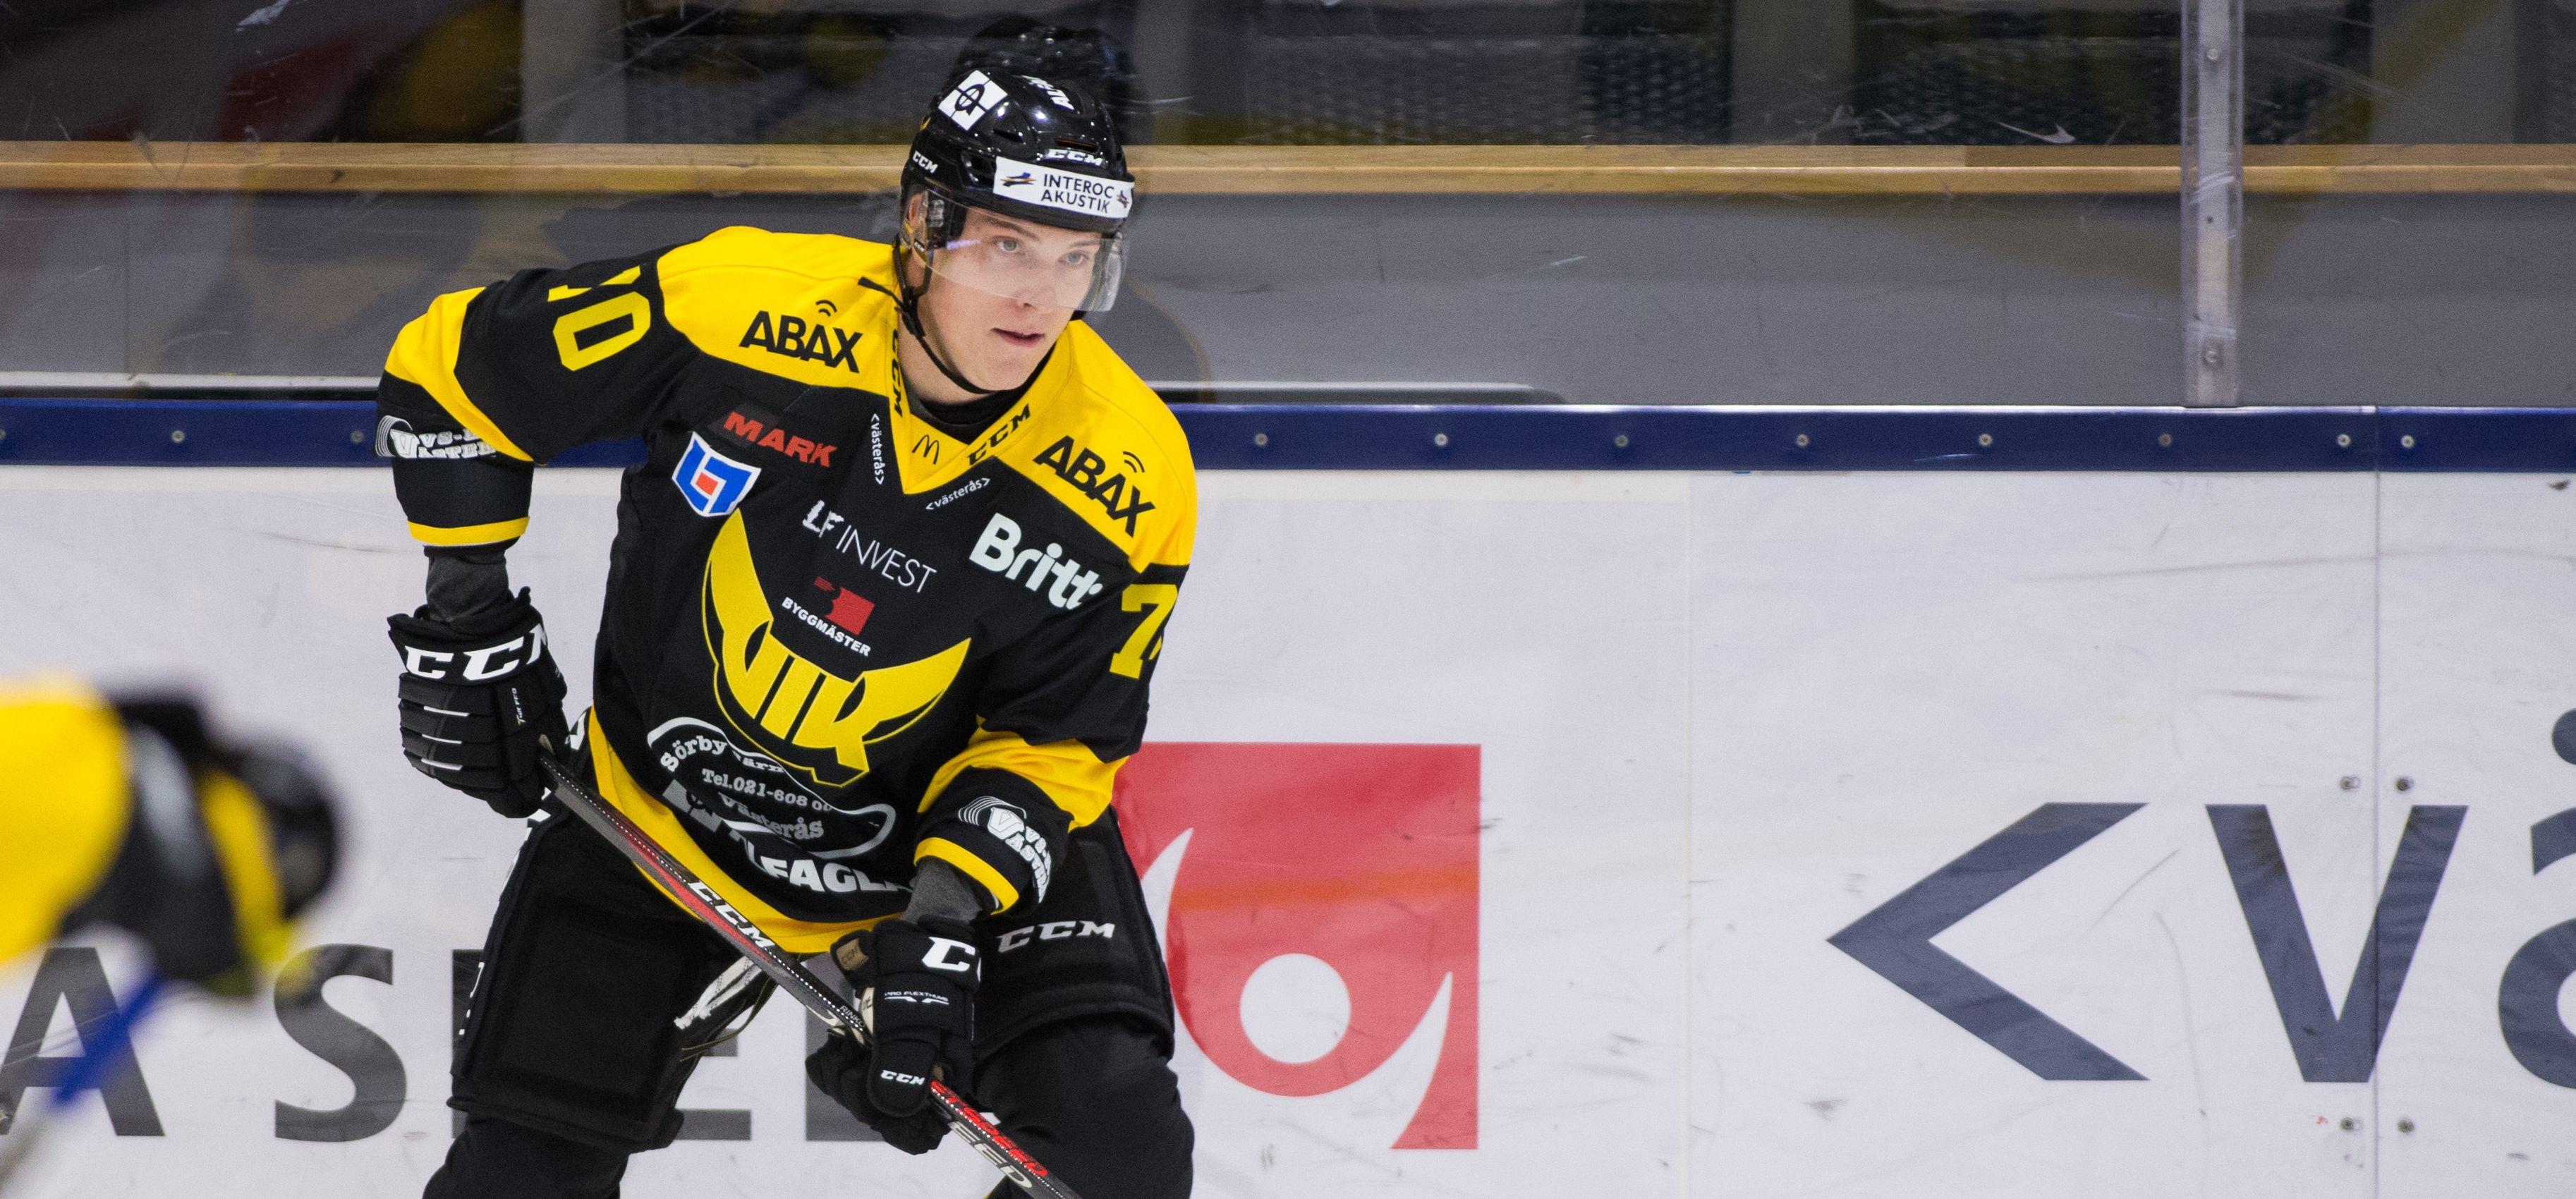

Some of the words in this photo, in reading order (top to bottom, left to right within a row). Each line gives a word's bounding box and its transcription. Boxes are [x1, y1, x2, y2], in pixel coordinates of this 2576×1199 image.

[913, 150, 937, 174] CCM
[1045, 149, 1104, 166] CCM
[1041, 189, 1111, 214] AKUSTIK
[1044, 174, 1115, 198] INTEROC
[739, 310, 863, 373] ABAX
[724, 411, 837, 468] MARK
[968, 403, 1031, 465] CCM
[1033, 435, 1155, 537] ABAX
[803, 500, 844, 538] LF
[836, 525, 937, 592] INVEST
[782, 597, 871, 657] BYGGMÄSTER
[660, 736, 727, 772] Sörby
[718, 792, 824, 839] Västerås
[688, 880, 776, 949] CCM
[996, 920, 1115, 952] CCM
[881, 1069, 925, 1085] CCM
